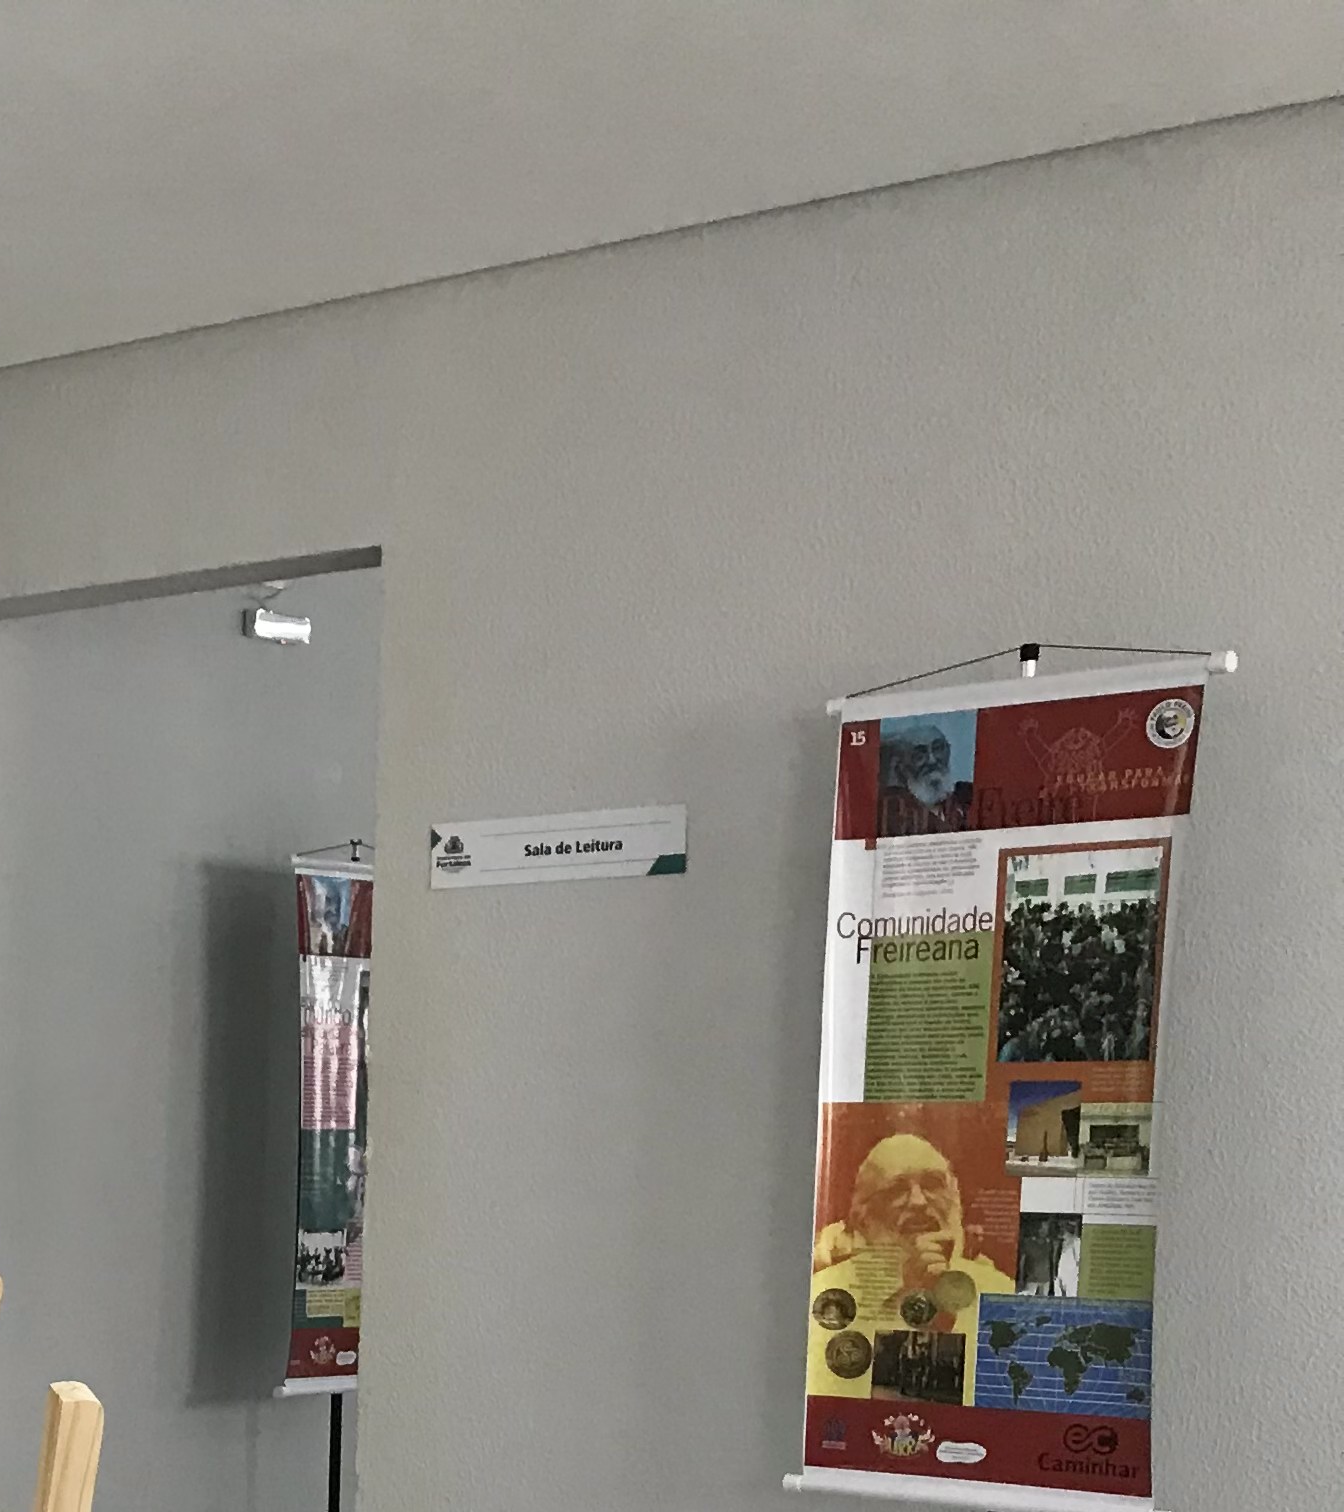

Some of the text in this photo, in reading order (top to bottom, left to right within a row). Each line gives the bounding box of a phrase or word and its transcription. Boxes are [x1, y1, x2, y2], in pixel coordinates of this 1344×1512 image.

[850, 730, 866, 747] 15
[1124, 766, 1164, 779] PARA
[523, 838, 623, 857] Sala de Leitura
[836, 905, 994, 939] Comunidade
[856, 935, 980, 965] Freireana
[1037, 1451, 1141, 1481] Caminhar
